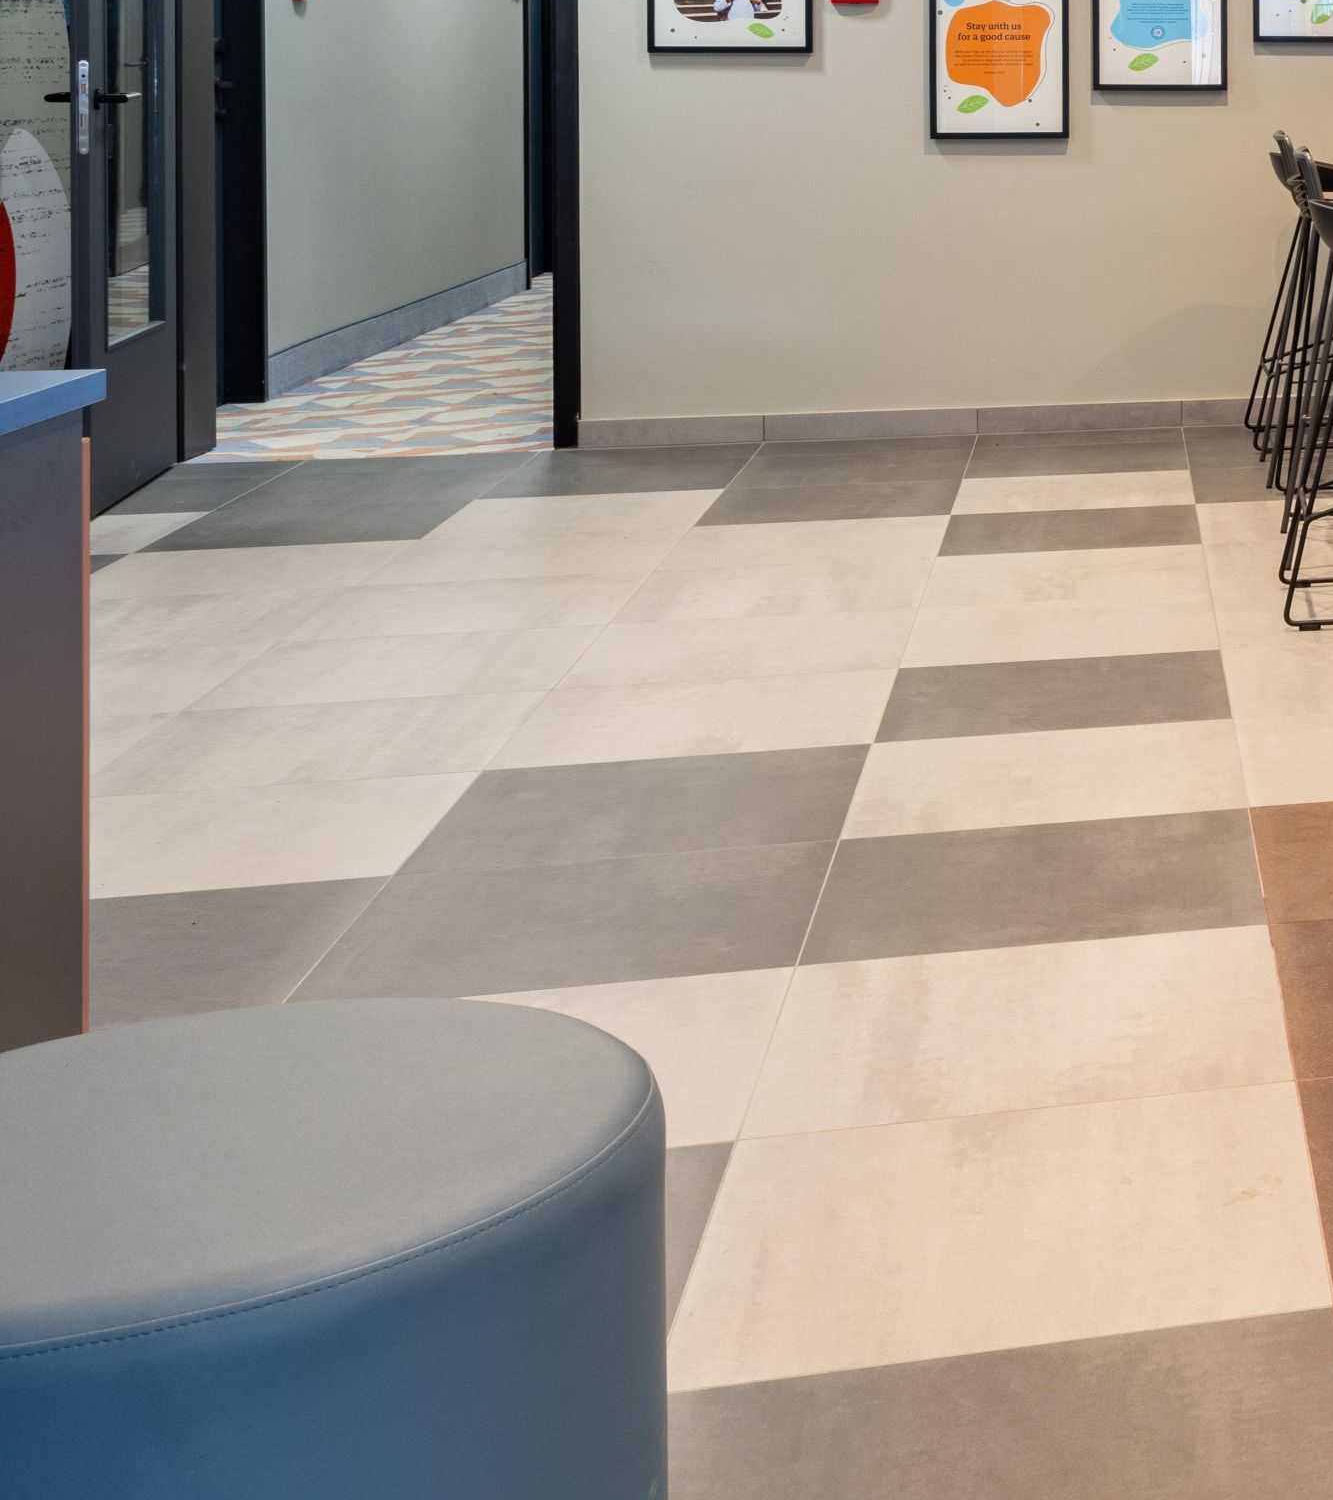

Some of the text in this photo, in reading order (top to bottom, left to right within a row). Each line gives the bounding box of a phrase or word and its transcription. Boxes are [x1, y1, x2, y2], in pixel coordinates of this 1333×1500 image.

[966, 22, 987, 32] Stay
[988, 22, 1009, 30] with
[957, 33, 973, 41] for
[980, 33, 1003, 42] good
